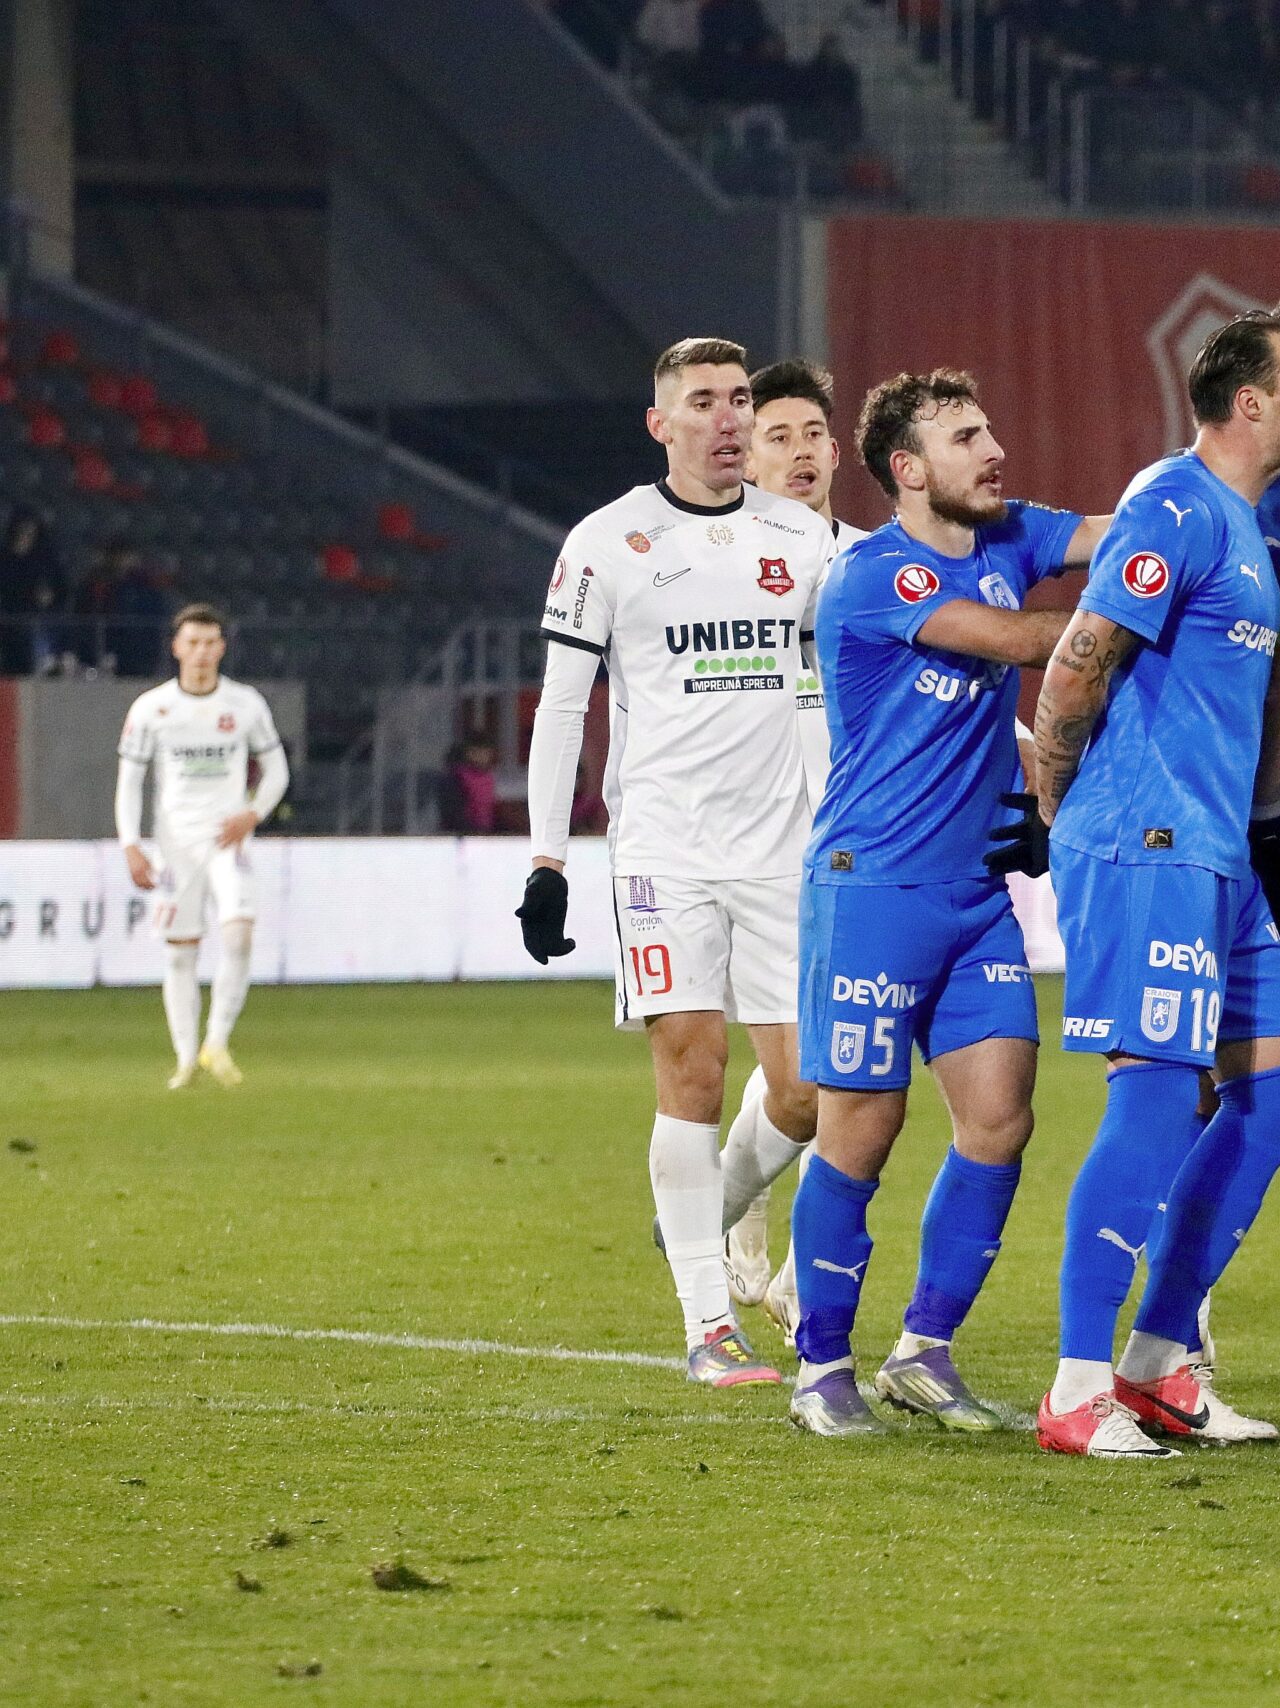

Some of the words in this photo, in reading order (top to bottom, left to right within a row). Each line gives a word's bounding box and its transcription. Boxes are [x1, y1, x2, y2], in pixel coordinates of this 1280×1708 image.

[573, 577, 590, 630] ESCUDO
[665, 619, 796, 655] UNIBET
[743, 678, 766, 690] SPRE
[629, 944, 673, 996] 19
[832, 972, 916, 1009] DEVIN
[1145, 988, 1180, 999] CRAIOVA
[1190, 987, 1220, 1053] 19
[870, 1016, 895, 1076] 5
